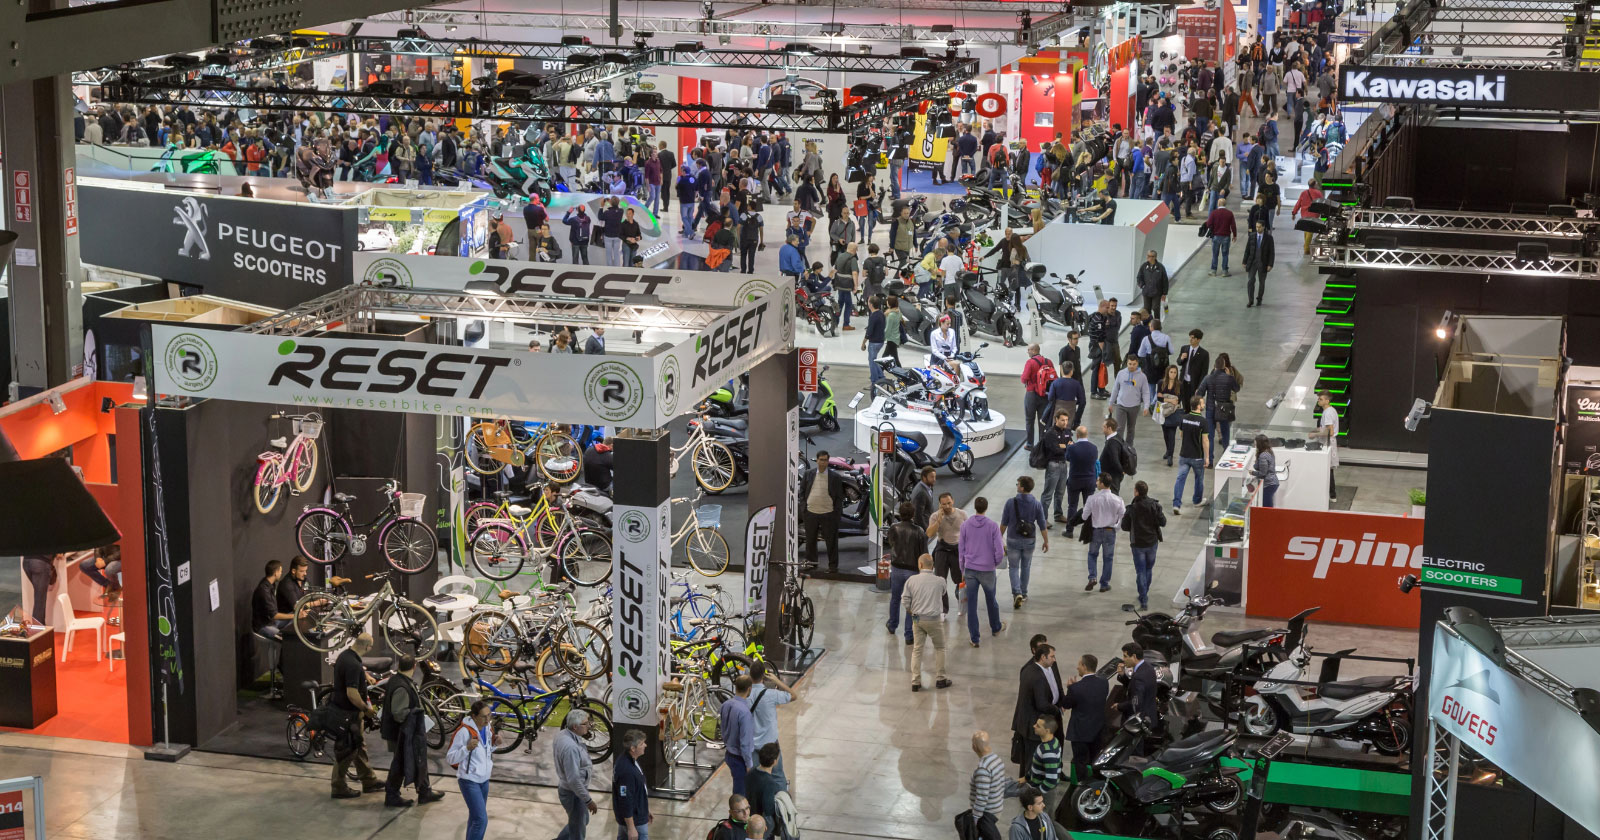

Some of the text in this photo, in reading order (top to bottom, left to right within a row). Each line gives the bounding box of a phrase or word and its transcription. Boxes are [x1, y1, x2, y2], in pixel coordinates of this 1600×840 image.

[1345, 71, 1505, 101] Kawasaki
[218, 222, 342, 263] PEUGEOT
[233, 251, 327, 286] SCOOTERS
[267, 339, 512, 400] RESET
[692, 302, 768, 389] RESET
[292, 393, 494, 416] www.resetbike.com
[788, 451, 797, 562] RESET
[748, 522, 769, 603] RESET
[1422, 556, 1486, 572] ELECTRIC
[1425, 570, 1498, 588] SCOOTERS
[618, 549, 643, 686] RESET
[658, 550, 667, 677] RESET
[1441, 695, 1498, 746] GOVECS
